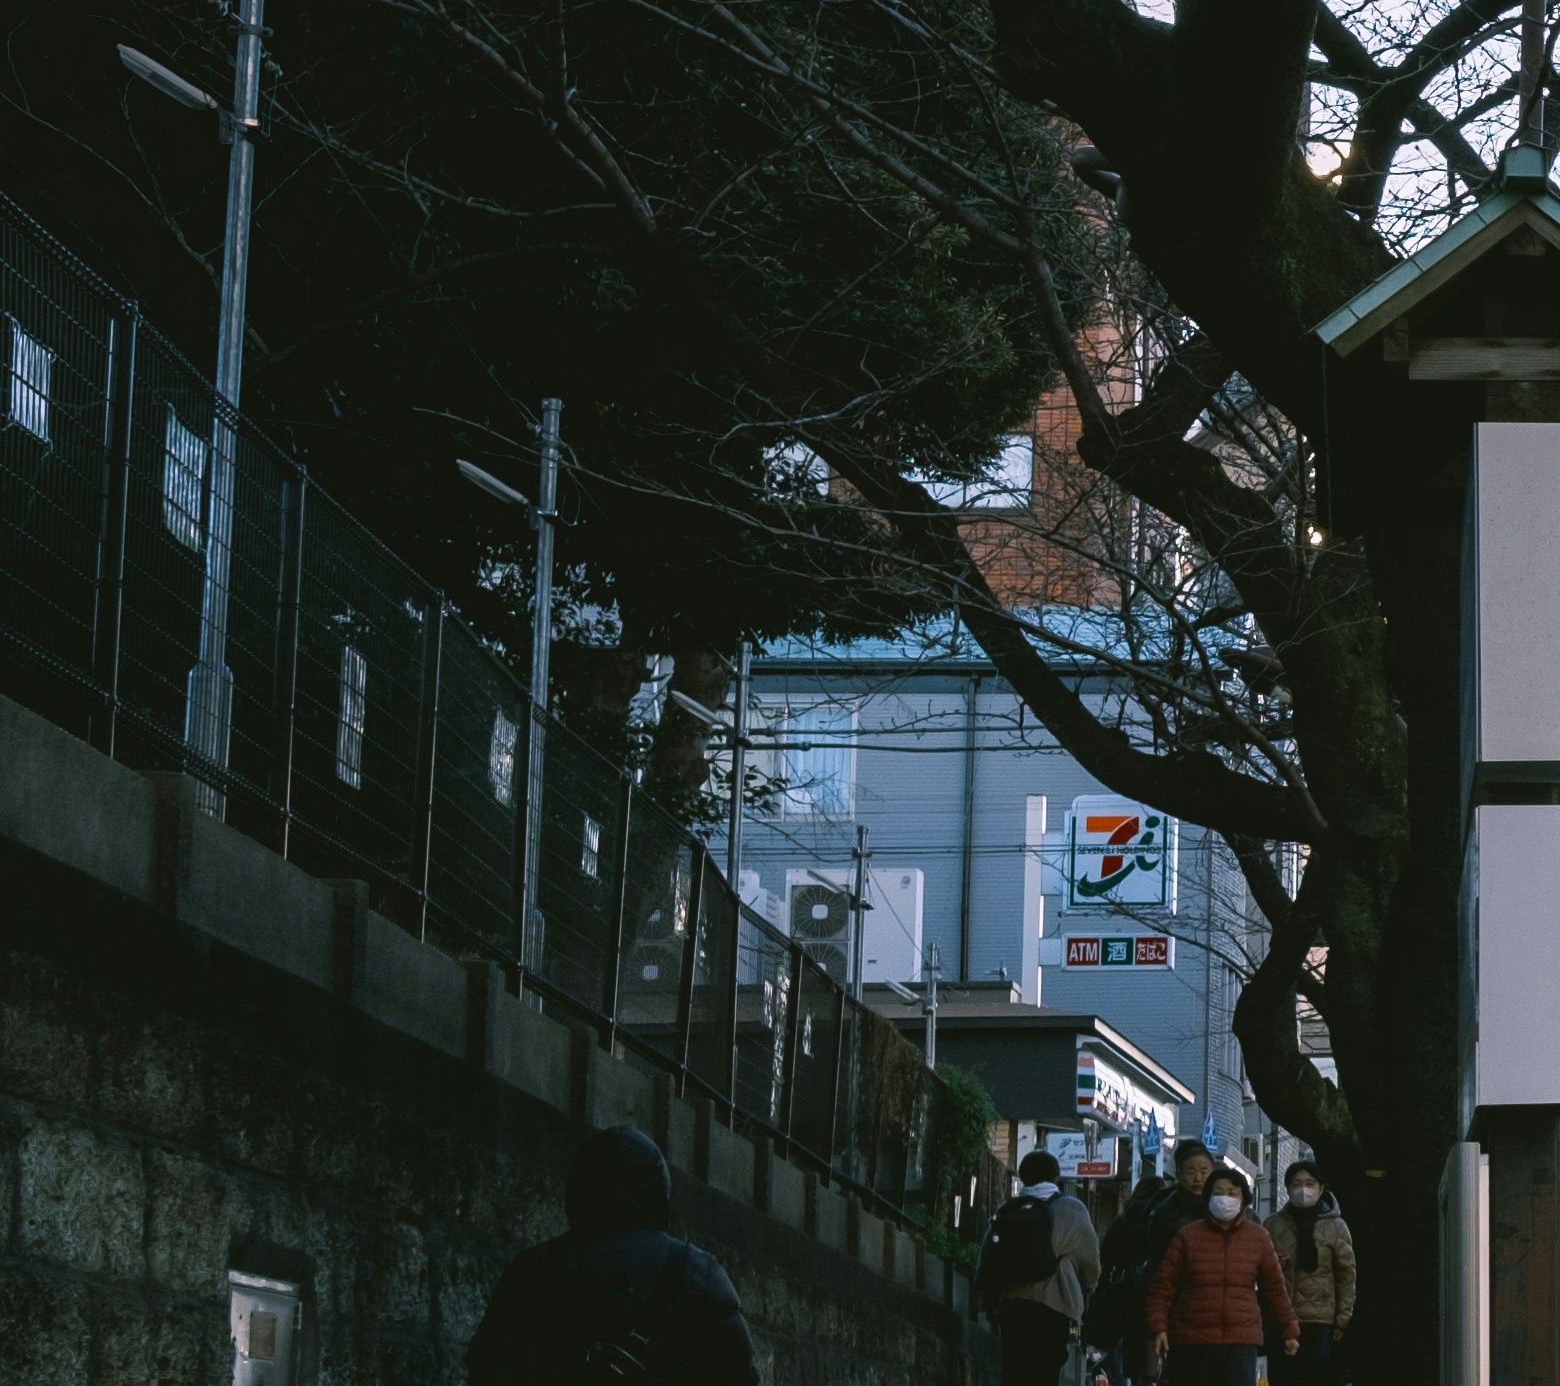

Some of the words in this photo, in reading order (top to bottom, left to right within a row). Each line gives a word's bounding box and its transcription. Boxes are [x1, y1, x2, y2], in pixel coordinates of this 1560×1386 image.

[1069, 942, 1098, 962] ATM
[1108, 941, 1127, 962] 酒
[1137, 940, 1166, 961] たばこ
